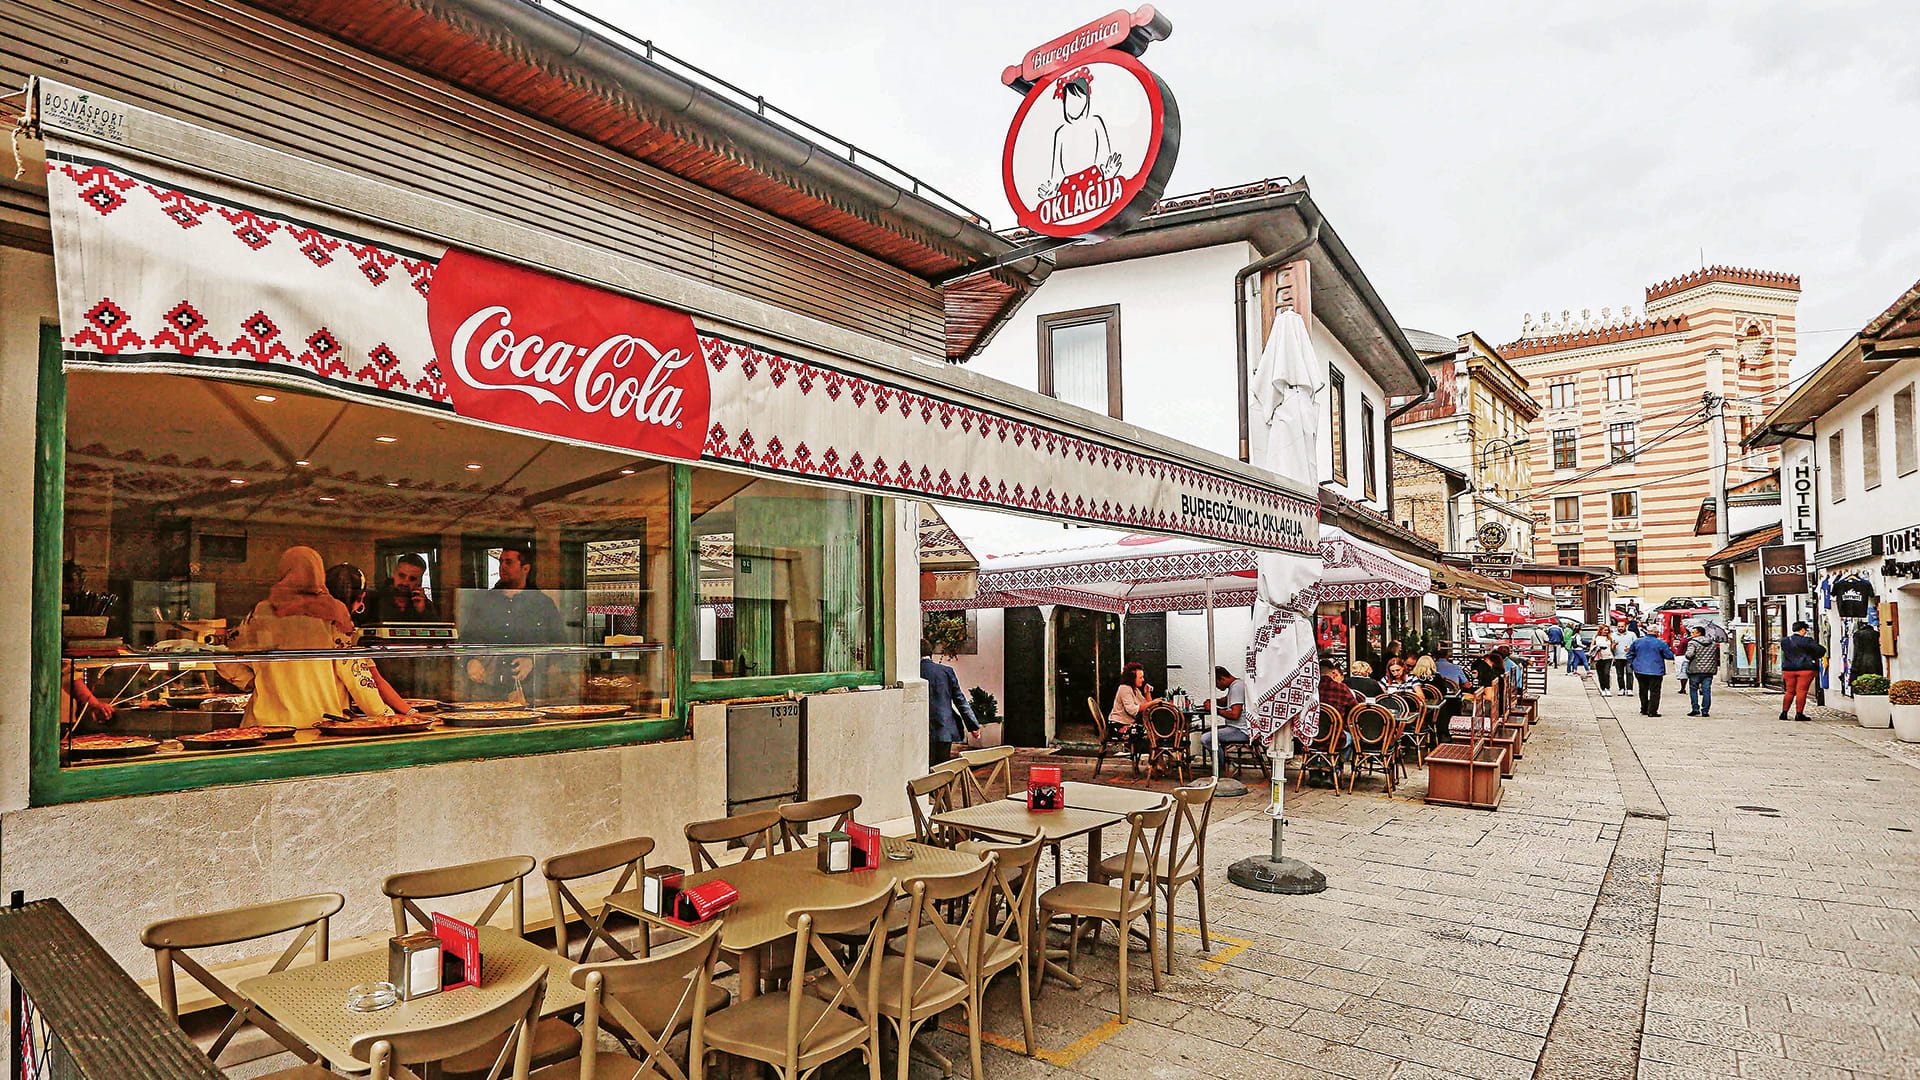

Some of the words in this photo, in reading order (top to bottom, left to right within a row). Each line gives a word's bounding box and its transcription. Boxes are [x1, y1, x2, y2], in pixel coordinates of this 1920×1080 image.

[1031, 20, 1120, 70] Buregdžinica
[45, 93, 124, 126] BOSNASPORT
[1039, 179, 1124, 225] OKLAGIJA
[451, 305, 694, 427] Coca-Cola
[1181, 494, 1261, 529] BUREGDŽINICA
[1262, 513, 1304, 538] OKLAGIJA
[1794, 466, 1811, 531] HOTEL
[1764, 564, 1805, 576] MOSS
[771, 706, 781, 718] TS
[782, 705, 798, 717] 320
